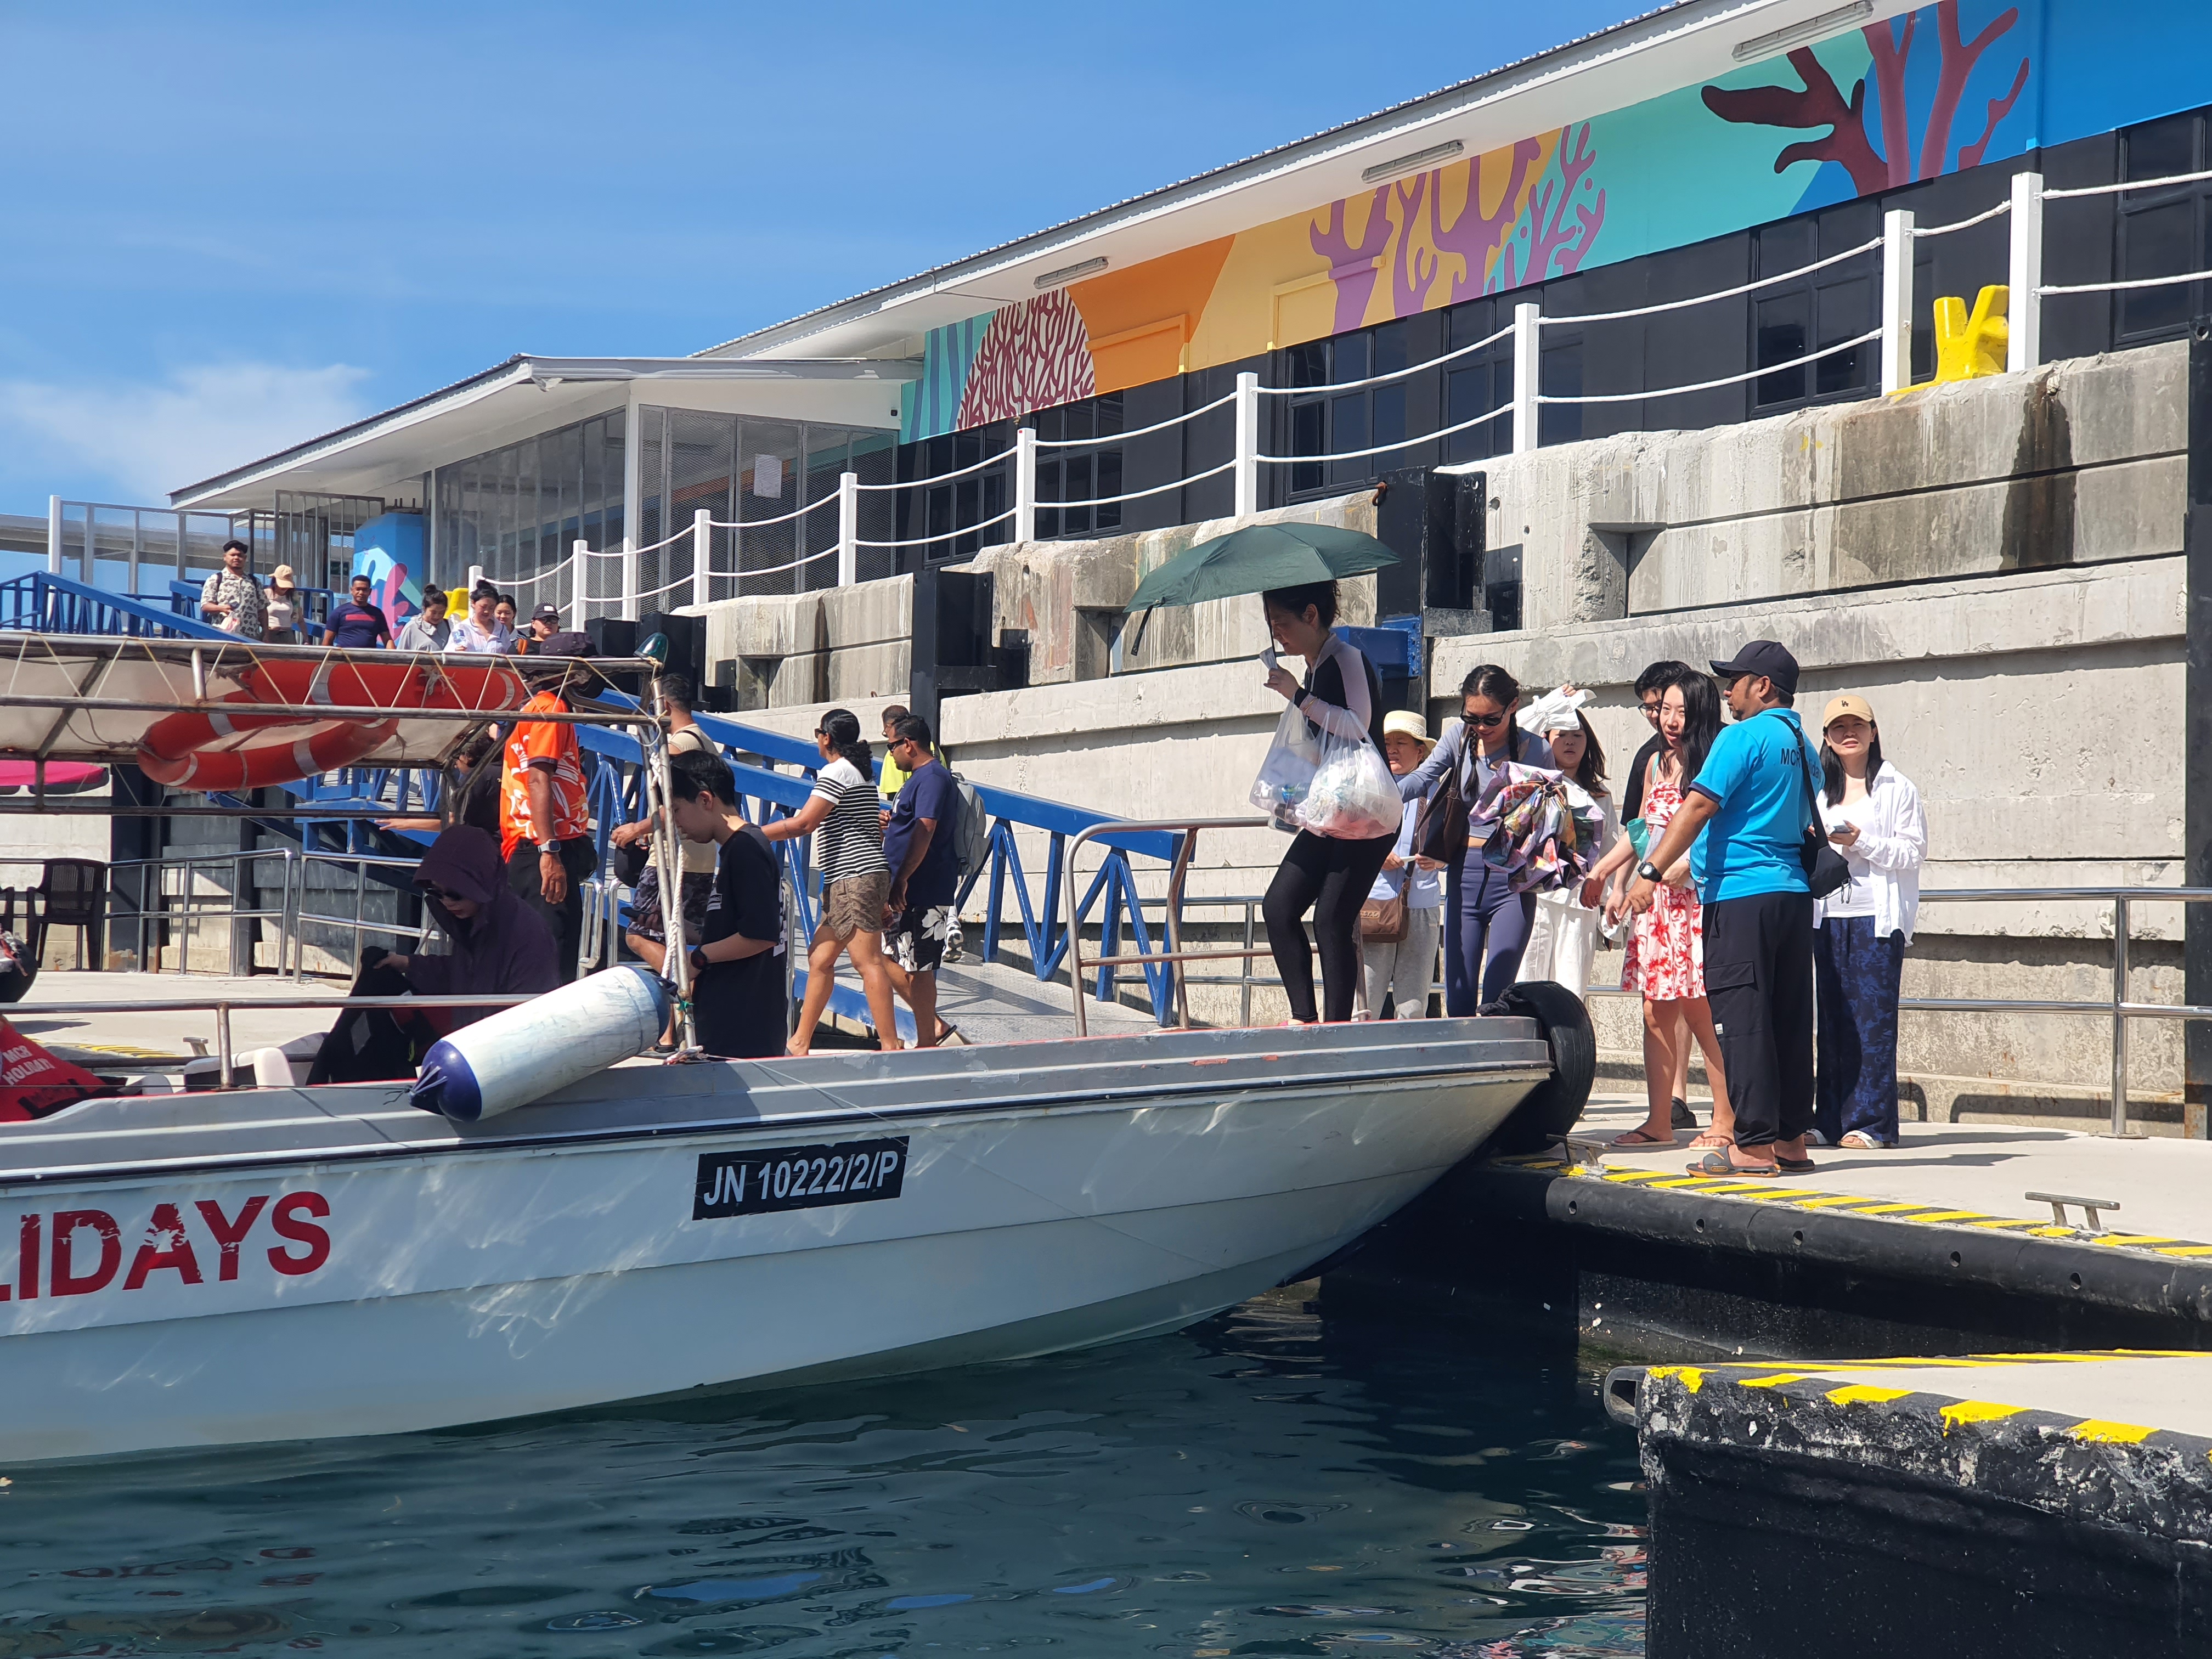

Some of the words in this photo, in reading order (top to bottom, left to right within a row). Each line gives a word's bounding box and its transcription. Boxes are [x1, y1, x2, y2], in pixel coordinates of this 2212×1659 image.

[1780, 748, 1801, 768] MCR
[2, 1045, 33, 1063] MCR
[703, 1165, 746, 1206] JN
[758, 1151, 898, 1200] 10222/2/P
